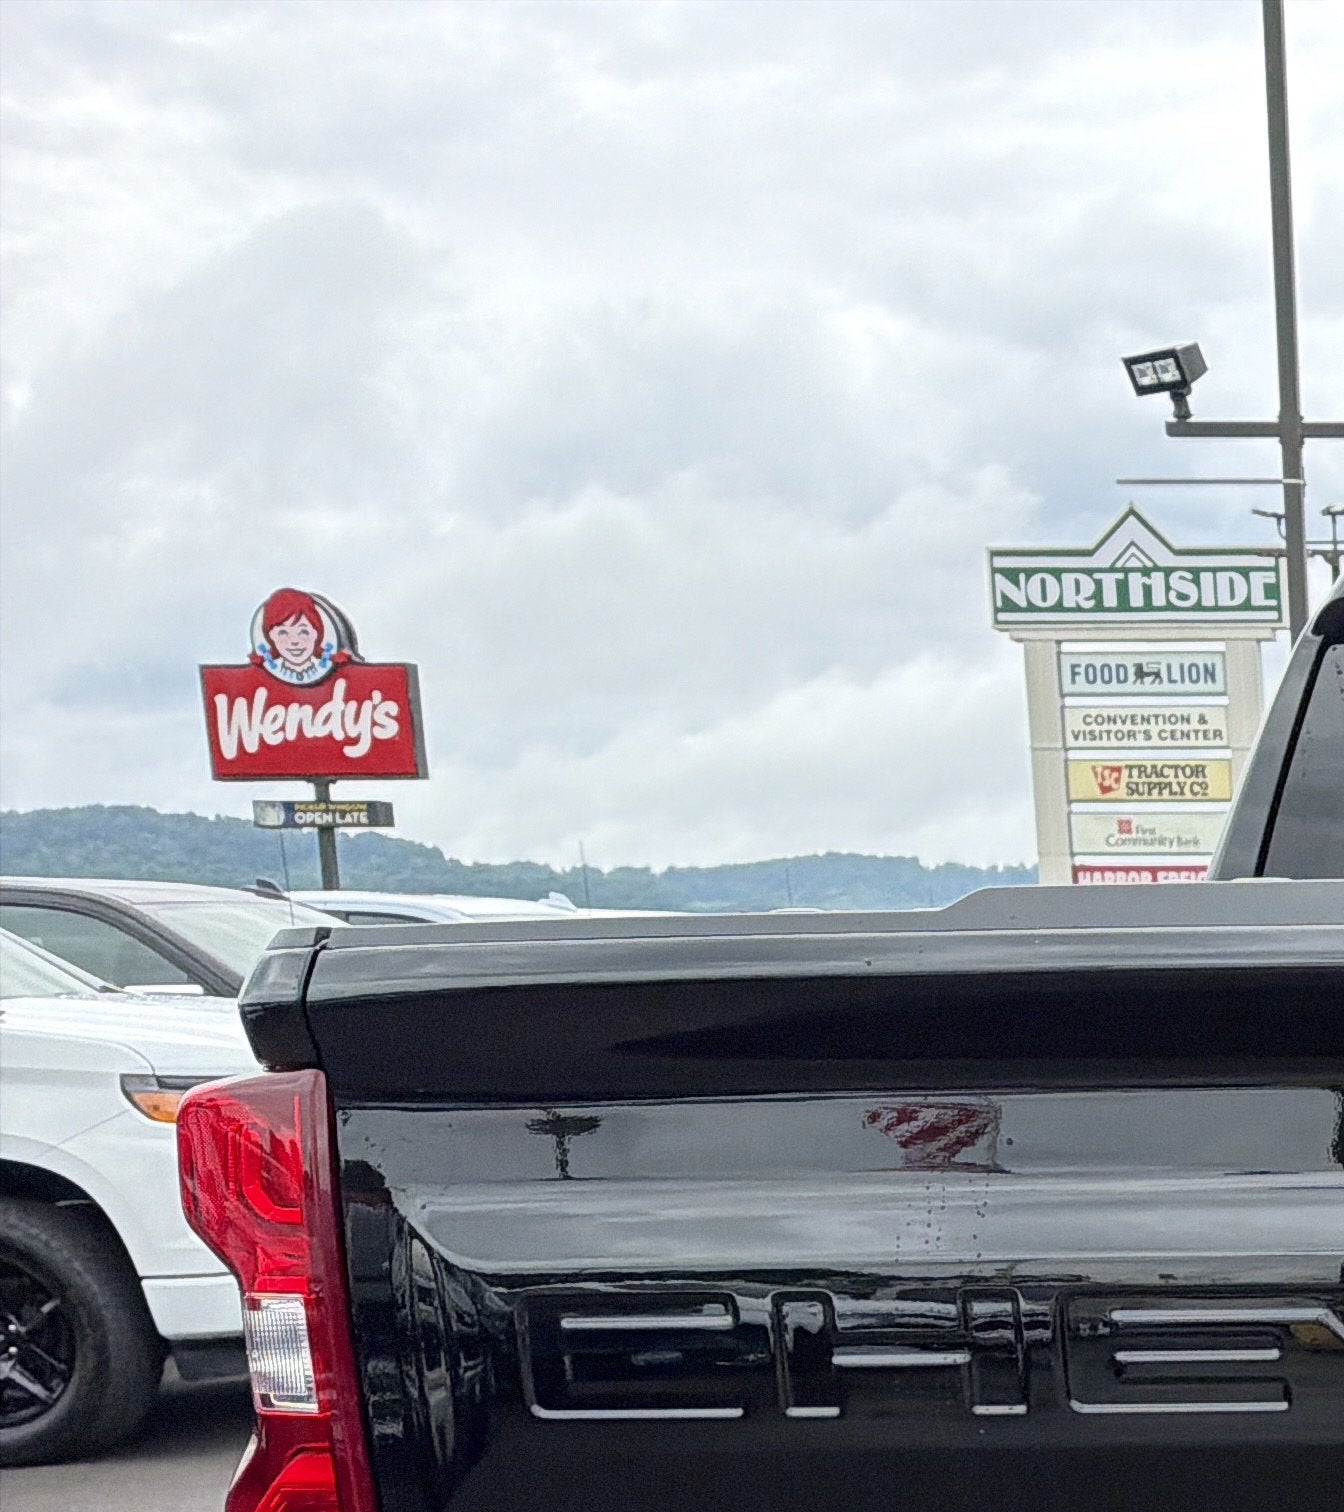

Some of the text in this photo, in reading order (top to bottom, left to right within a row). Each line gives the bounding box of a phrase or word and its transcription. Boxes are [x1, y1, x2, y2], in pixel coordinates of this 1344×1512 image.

[994, 571, 1278, 608] NORTHSIDE
[1070, 662, 1217, 685] FOOD LION
[214, 678, 399, 760] Wendy's
[1082, 713, 1209, 726] CONVENTION &
[1071, 729, 1224, 742] VISITOR'S CENTER
[1125, 764, 1208, 779] TRACTOR
[1126, 781, 1187, 797] SUPPLY
[294, 811, 369, 824] OPEN LATE
